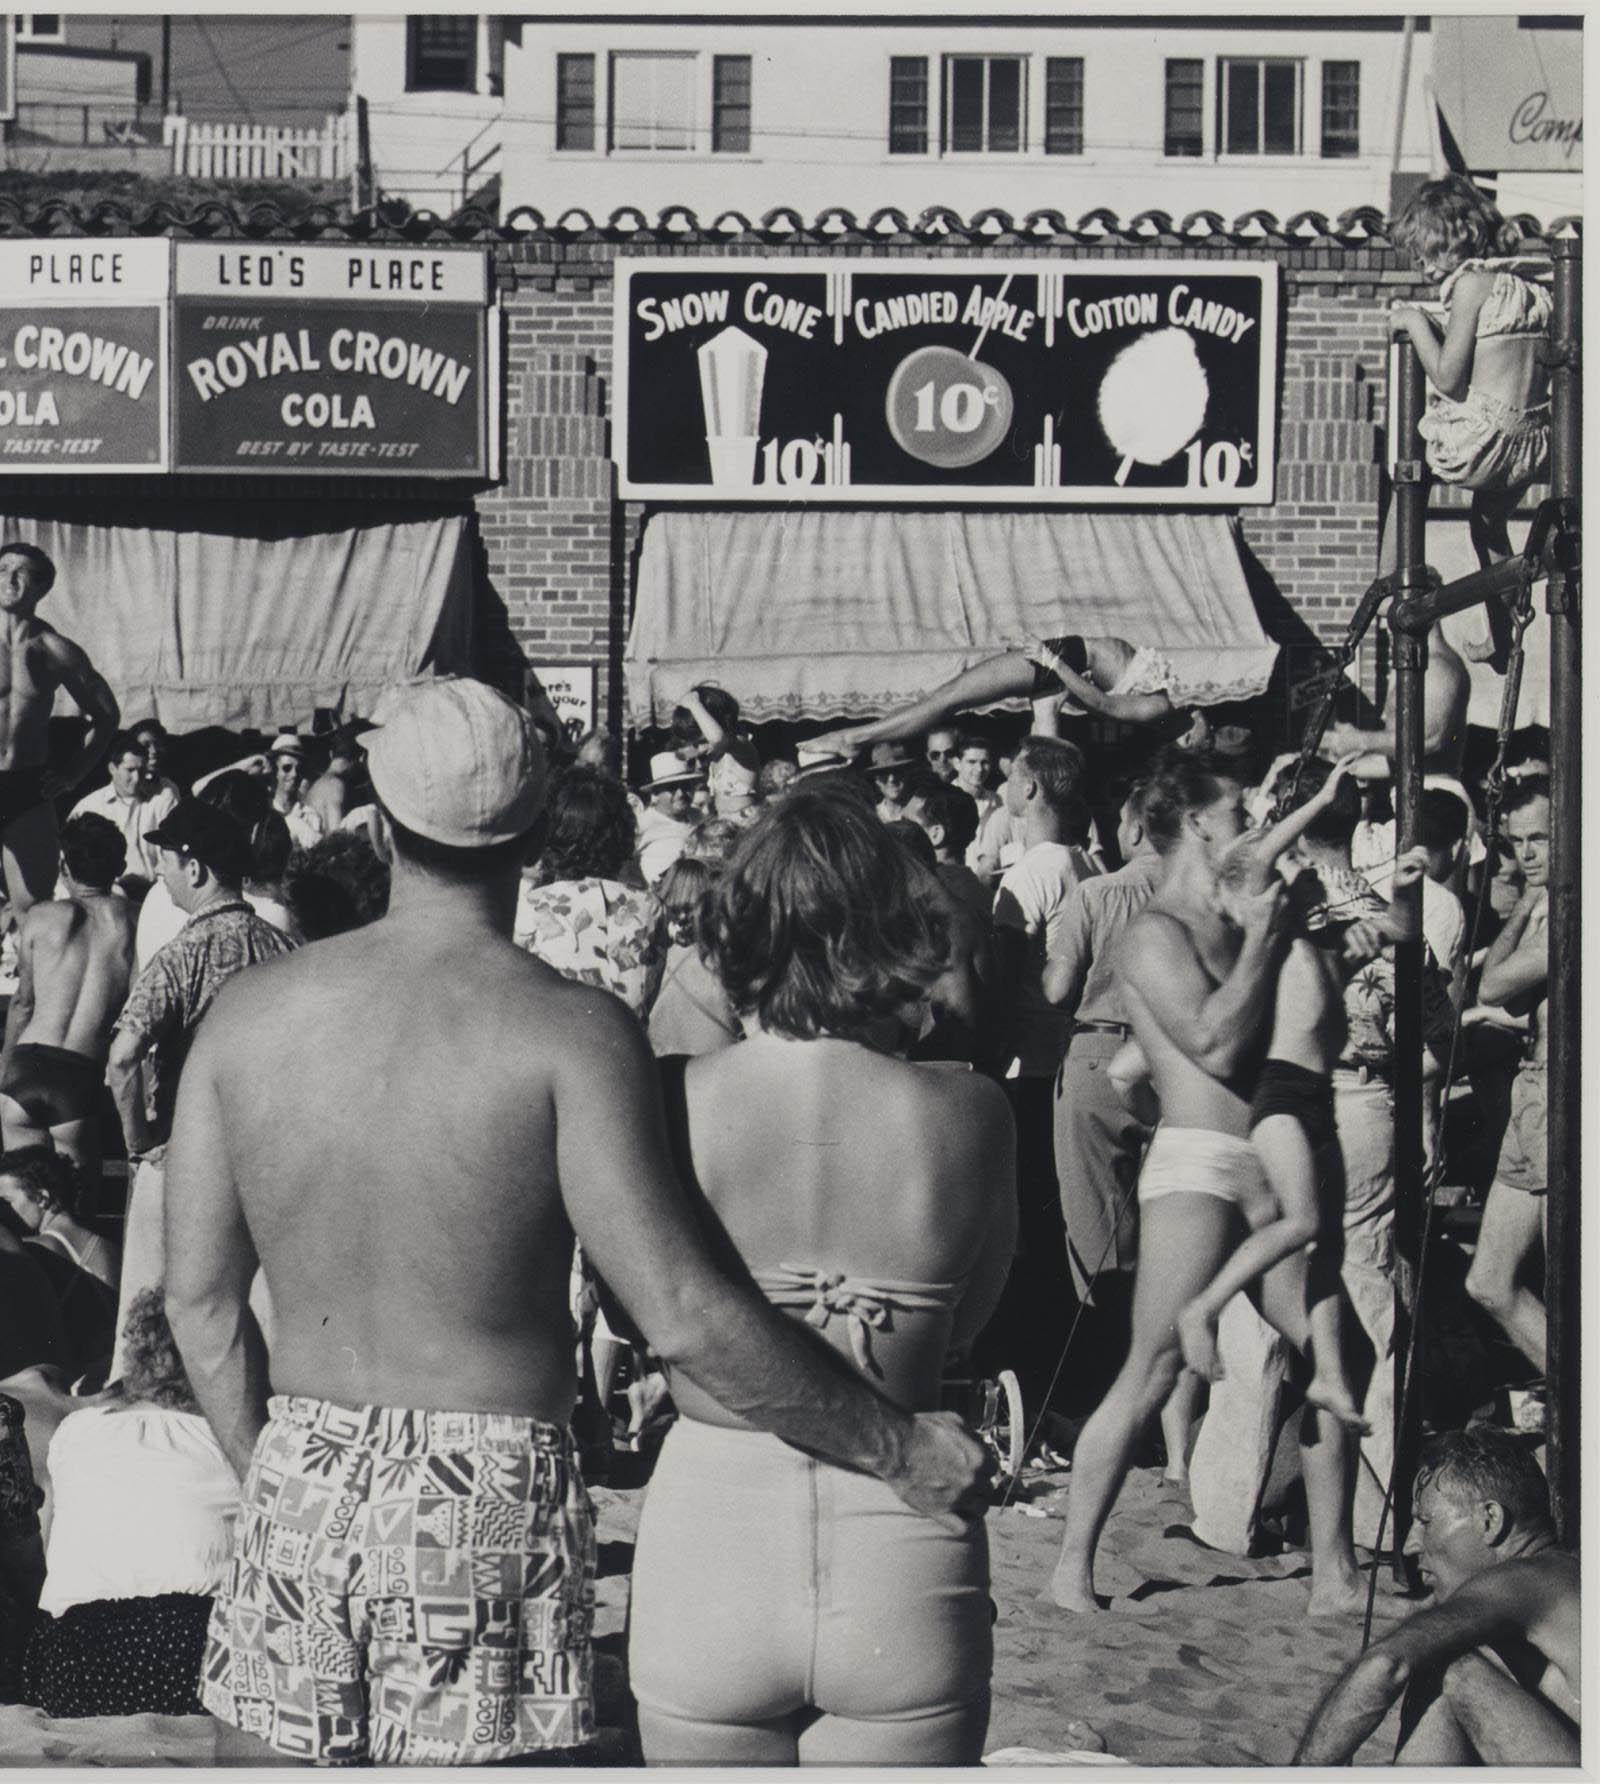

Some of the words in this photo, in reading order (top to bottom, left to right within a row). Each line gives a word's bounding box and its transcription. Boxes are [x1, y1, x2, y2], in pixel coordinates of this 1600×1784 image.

[30, 253, 123, 285] PLACE
[219, 250, 305, 287] LEO'S
[348, 258, 444, 290] PLACE
[203, 315, 263, 330] DRINK
[14, 325, 154, 400] CROWN
[187, 329, 321, 402] ROYAL
[329, 328, 472, 405] CROWN
[281, 393, 376, 429] COLA
[3, 438, 102, 454] TASTE-TEST
[237, 442, 284, 456] BEST
[288, 443, 314, 457] BY
[318, 443, 419, 457] TASTE-TEST
